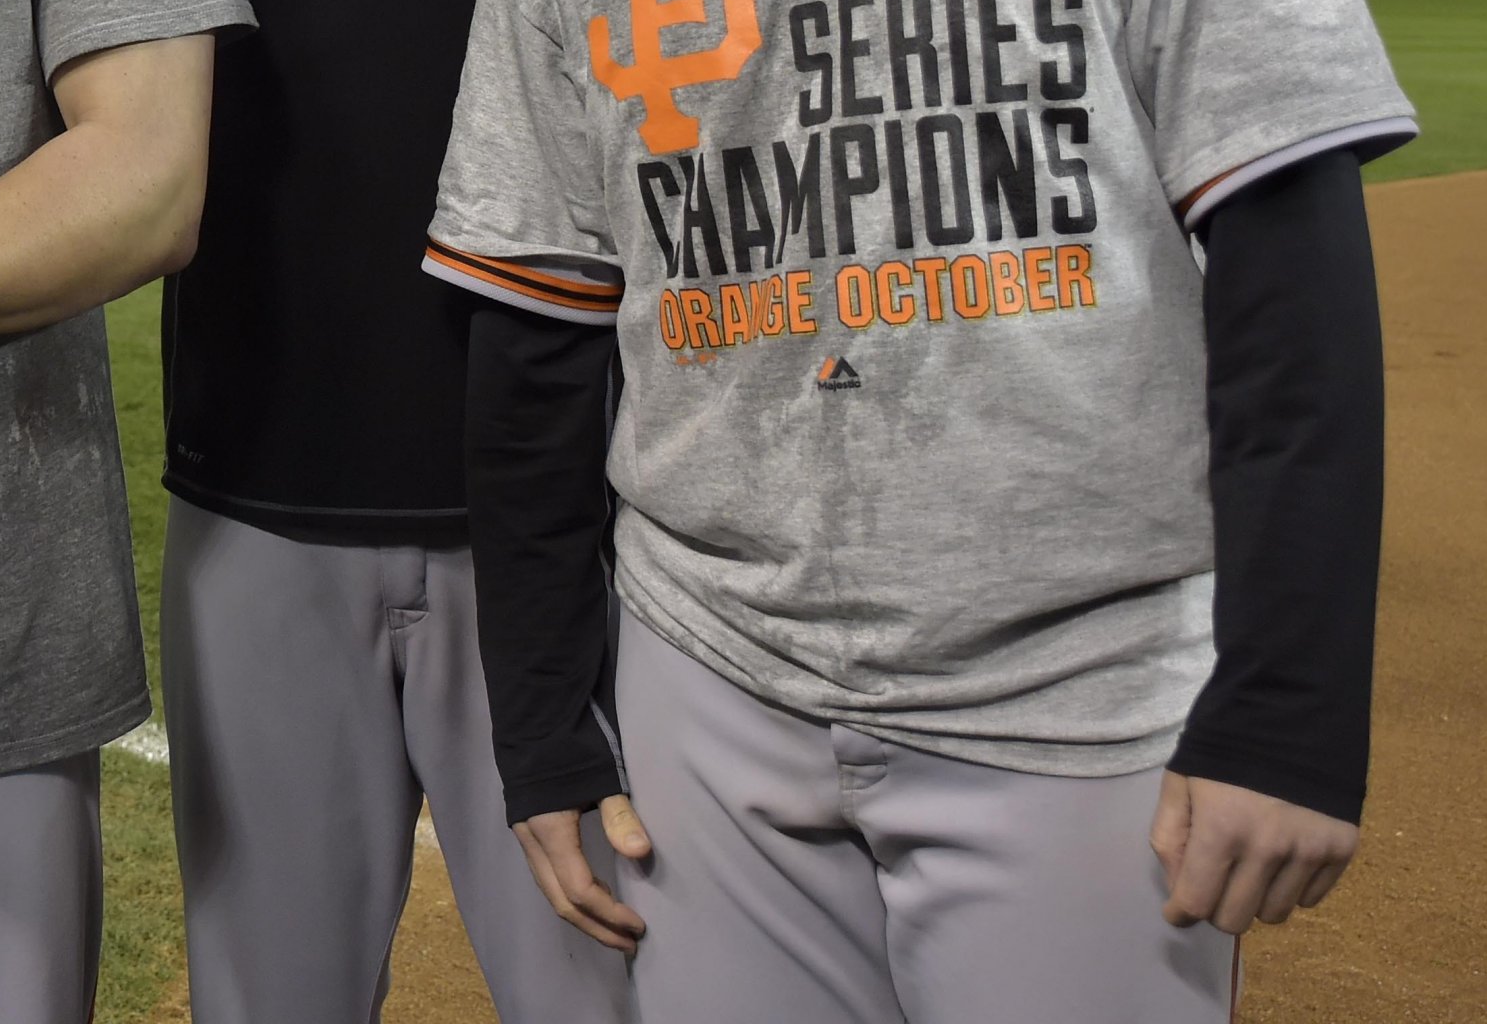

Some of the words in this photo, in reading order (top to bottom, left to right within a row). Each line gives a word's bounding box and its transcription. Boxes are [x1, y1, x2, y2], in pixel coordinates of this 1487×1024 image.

[637, 107, 1098, 279] CHAMPIONS
[658, 270, 819, 351] ORANGE
[835, 244, 1098, 330] OCTOBER
[817, 378, 862, 392] Majestic
